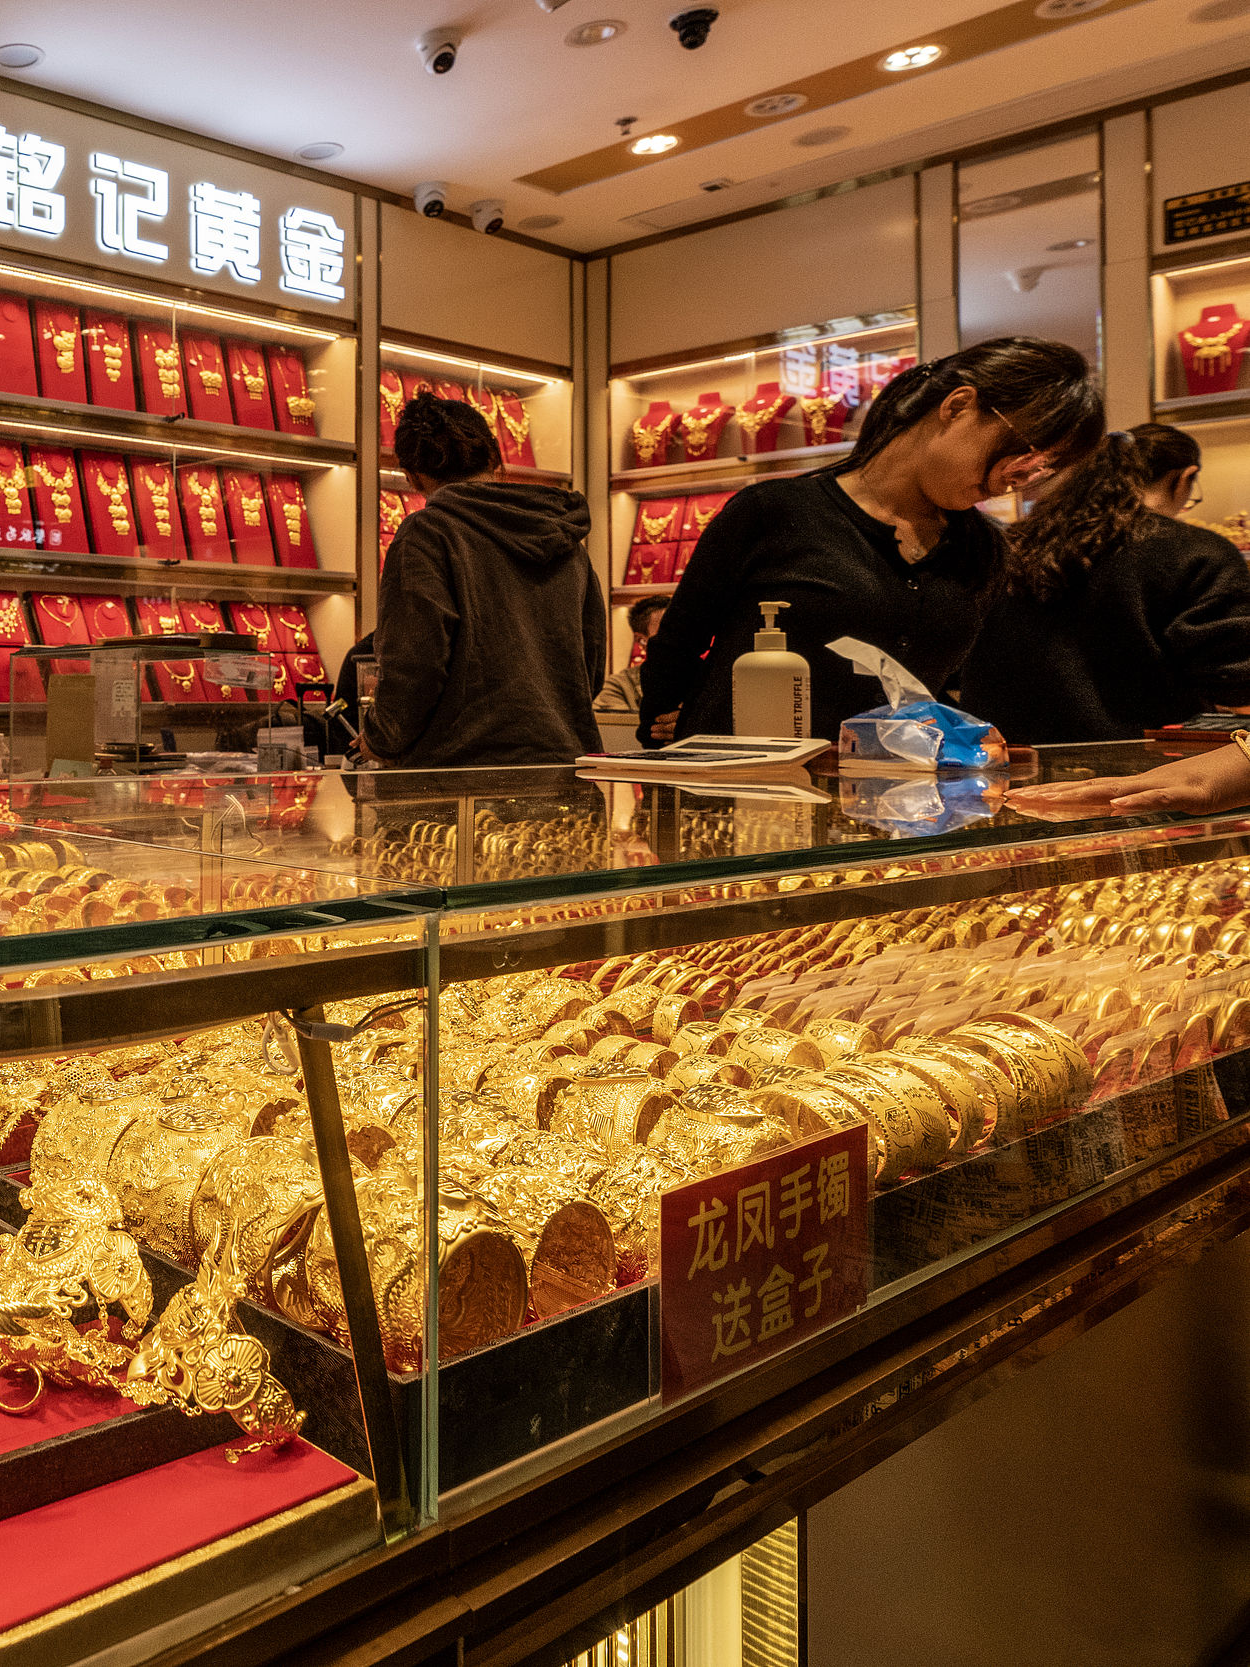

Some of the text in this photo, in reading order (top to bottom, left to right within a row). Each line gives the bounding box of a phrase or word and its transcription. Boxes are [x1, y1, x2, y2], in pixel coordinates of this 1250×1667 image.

[794, 676, 803, 713] TRUFFLE
[687, 1150, 849, 1281] 龙凤手镯
[711, 1243, 832, 1363] 送盒子
